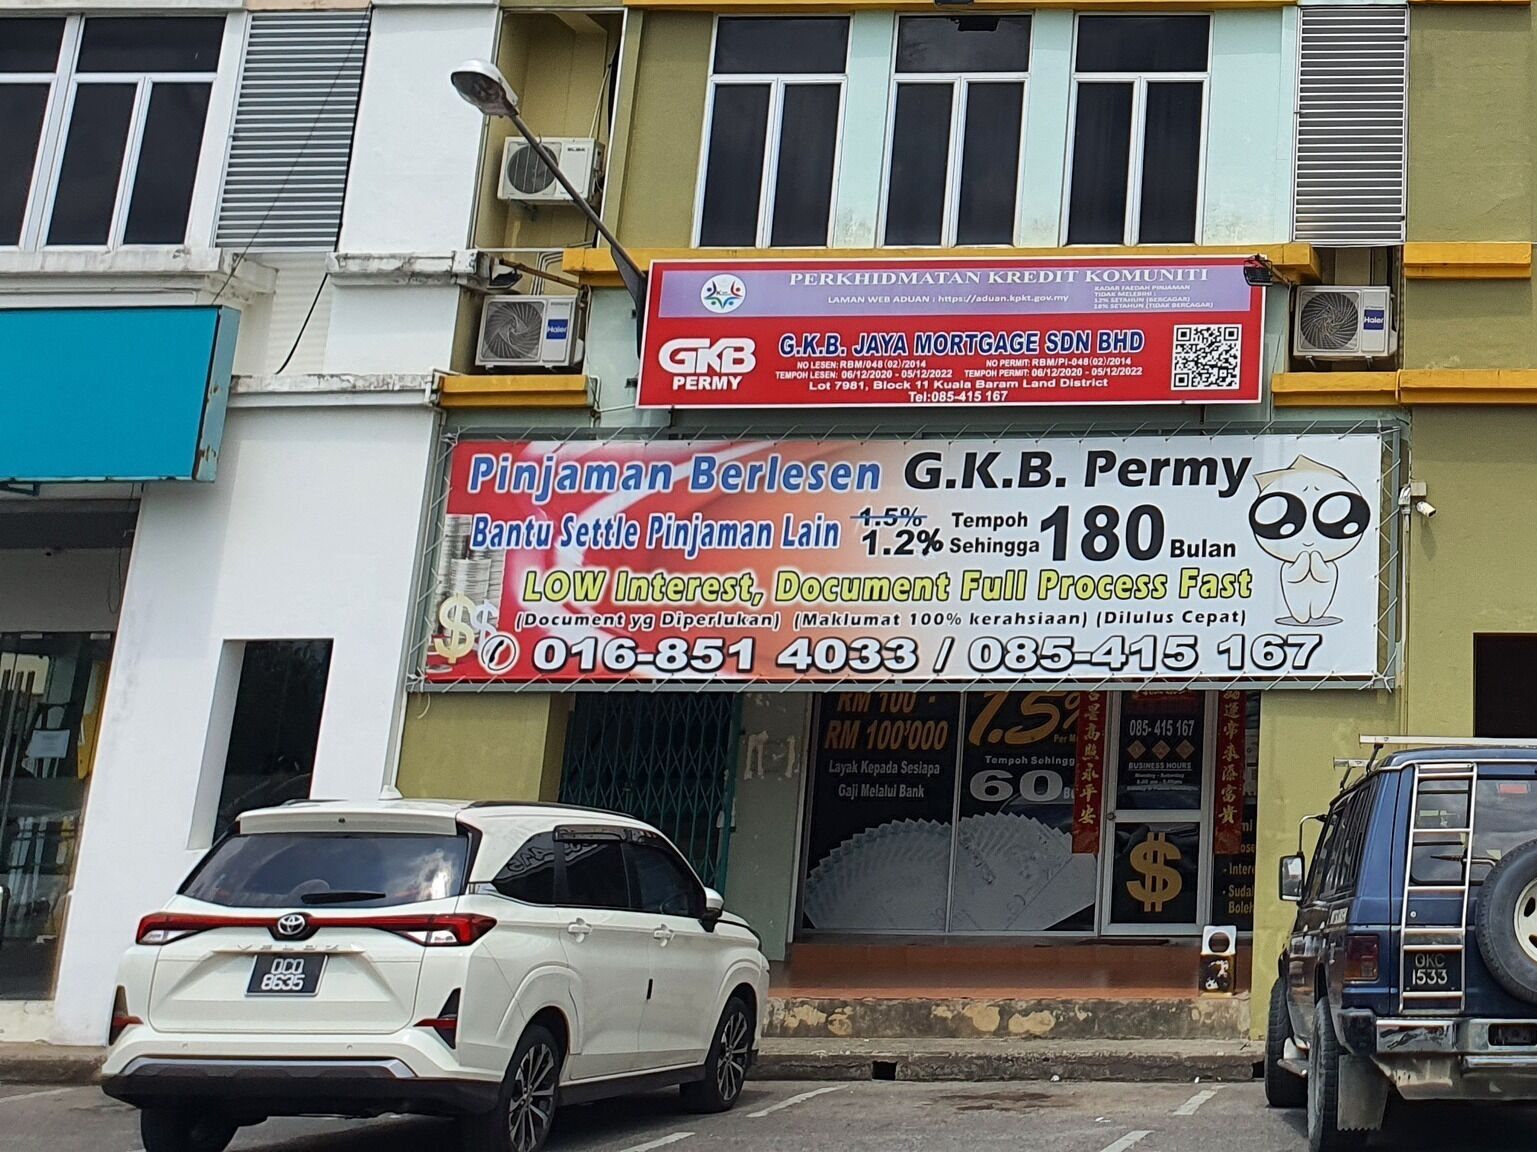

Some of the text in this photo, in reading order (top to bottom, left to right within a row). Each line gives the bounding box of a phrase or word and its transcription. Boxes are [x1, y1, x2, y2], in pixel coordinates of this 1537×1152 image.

[789, 268, 1209, 286] PERKHIDMATAN KREDIT KOMUNITI
[828, 295, 866, 304] LAMAN
[868, 295, 890, 303] WEB
[893, 295, 930, 303] ADUAN
[938, 294, 1069, 304] https://aduan.kpkt.gov.my
[1364, 316, 1384, 324] Haier
[547, 325, 567, 334] Haier
[779, 329, 1145, 358] G.K.B. JAYA MORTGAGE SDN BHD
[658, 337, 757, 374] GKB
[986, 359, 998, 367] NO
[1000, 359, 1030, 367] PERMIT:
[797, 361, 808, 369] NO
[809, 361, 839, 369] LESEN:
[965, 369, 997, 378] TEMPOH
[999, 369, 1030, 377] PERMIT:
[1031, 368, 1083, 377] 06/12/2020
[1091, 367, 1143, 376] 05/12/2022
[672, 375, 742, 390] PERMY
[776, 371, 808, 379] TEMPOH
[810, 371, 838, 379] LESEN:
[841, 370, 892, 379] 06/12/2020
[901, 369, 952, 378] 05/12/2022
[809, 378, 1109, 391] Lot 7981, Block 11 Kuala Baram Land District
[908, 391, 1008, 402] Tel:085-415 167
[470, 450, 1252, 501] Pinjaman Berlesen G.K.B. Permy
[952, 511, 1029, 532] Tempoh
[470, 514, 839, 558] Bantu Settle Pinjaman Lain
[861, 504, 1237, 562] 1.2% Sehingga 180 Bulan
[522, 567, 1253, 607] LOW Interest, Document Full Process Fast
[515, 610, 1247, 631] (Document yg Diperlukan) (Maklumat 100% kerahsiaan) (Dilulus Cepat)
[532, 634, 1323, 674] 016-851 4033 / 085-415 167
[837, 691, 919, 714] RM 100
[824, 720, 861, 750] RM
[1154, 719, 1173, 736] 415
[1176, 719, 1195, 736] 167
[829, 760, 940, 778] Layak Kepada Sesiapa
[985, 755, 1077, 767] Tempoh Sehingg
[838, 784, 924, 800] Gaji Melalui Bank
[970, 769, 1063, 802] 60
[261, 974, 305, 990] 8635
[1412, 968, 1448, 985] 1533
